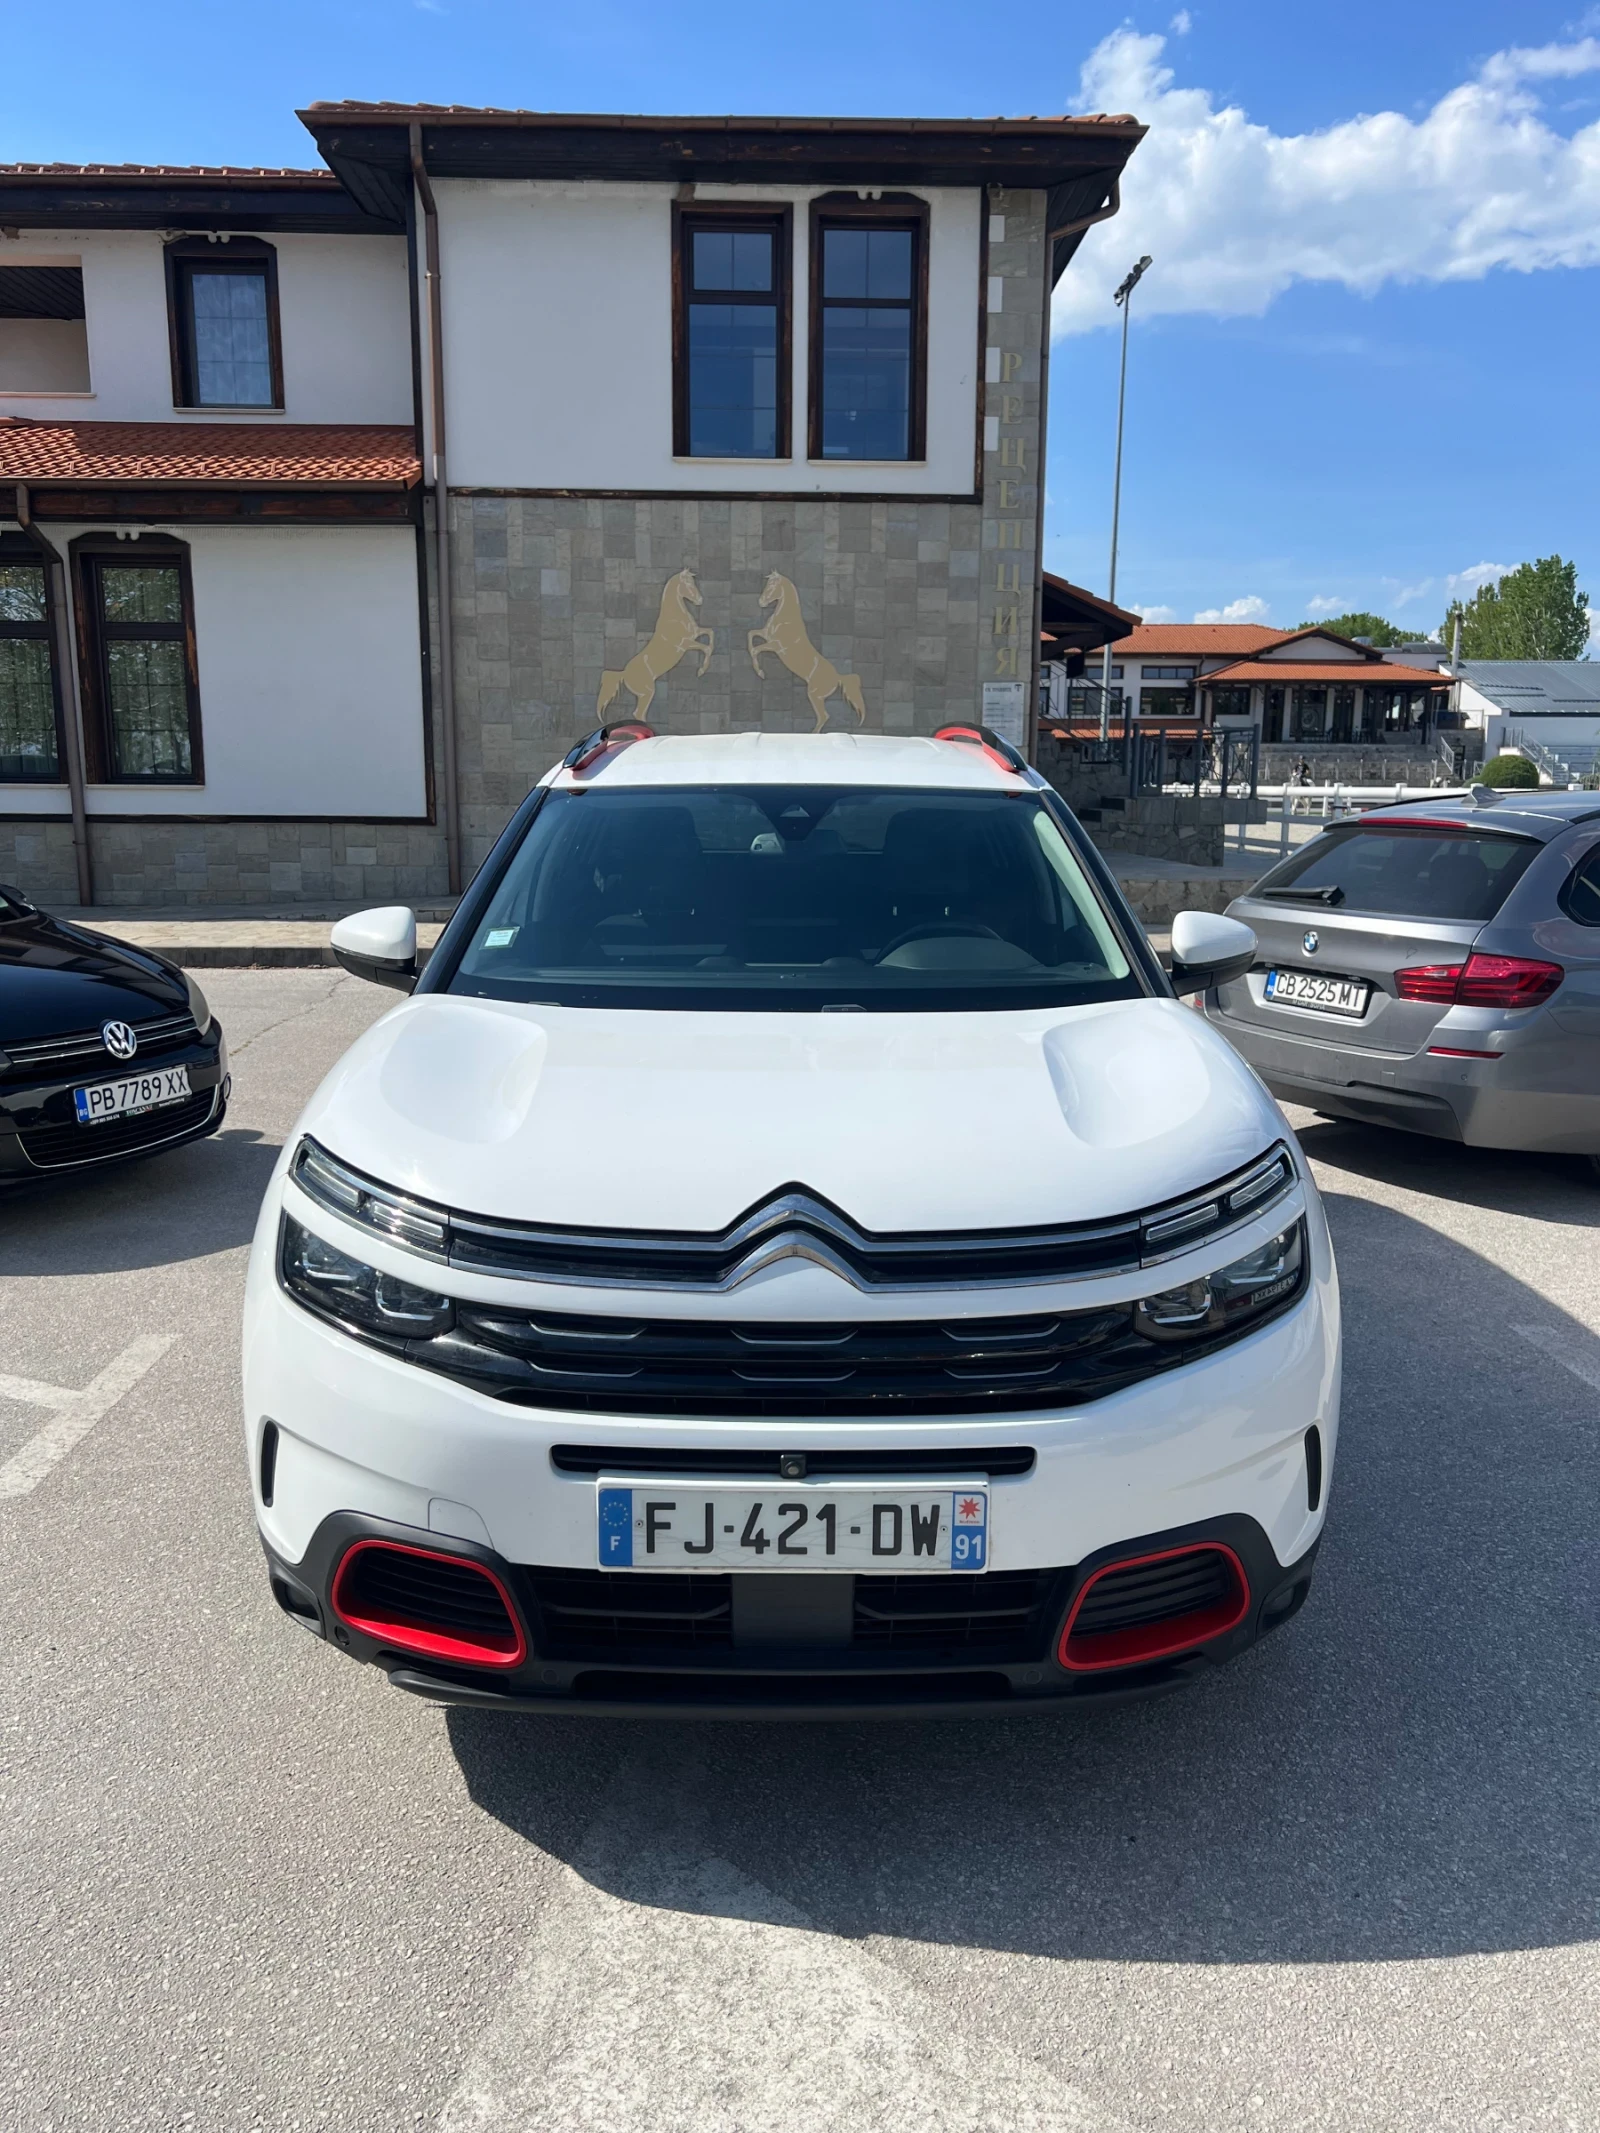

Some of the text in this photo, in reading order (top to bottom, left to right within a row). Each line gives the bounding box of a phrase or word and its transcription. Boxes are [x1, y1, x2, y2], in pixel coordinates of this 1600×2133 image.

[992, 352, 1026, 676] РЕЦЕПЦИЯ
[1276, 974, 1365, 1008] CB 2525 MT
[90, 1069, 187, 1113] PB 7789 XX
[79, 1107, 88, 1117] BG
[610, 1535, 621, 1551] F
[645, 1502, 941, 1556] FJ-421-DW
[955, 1534, 982, 1560] 91
